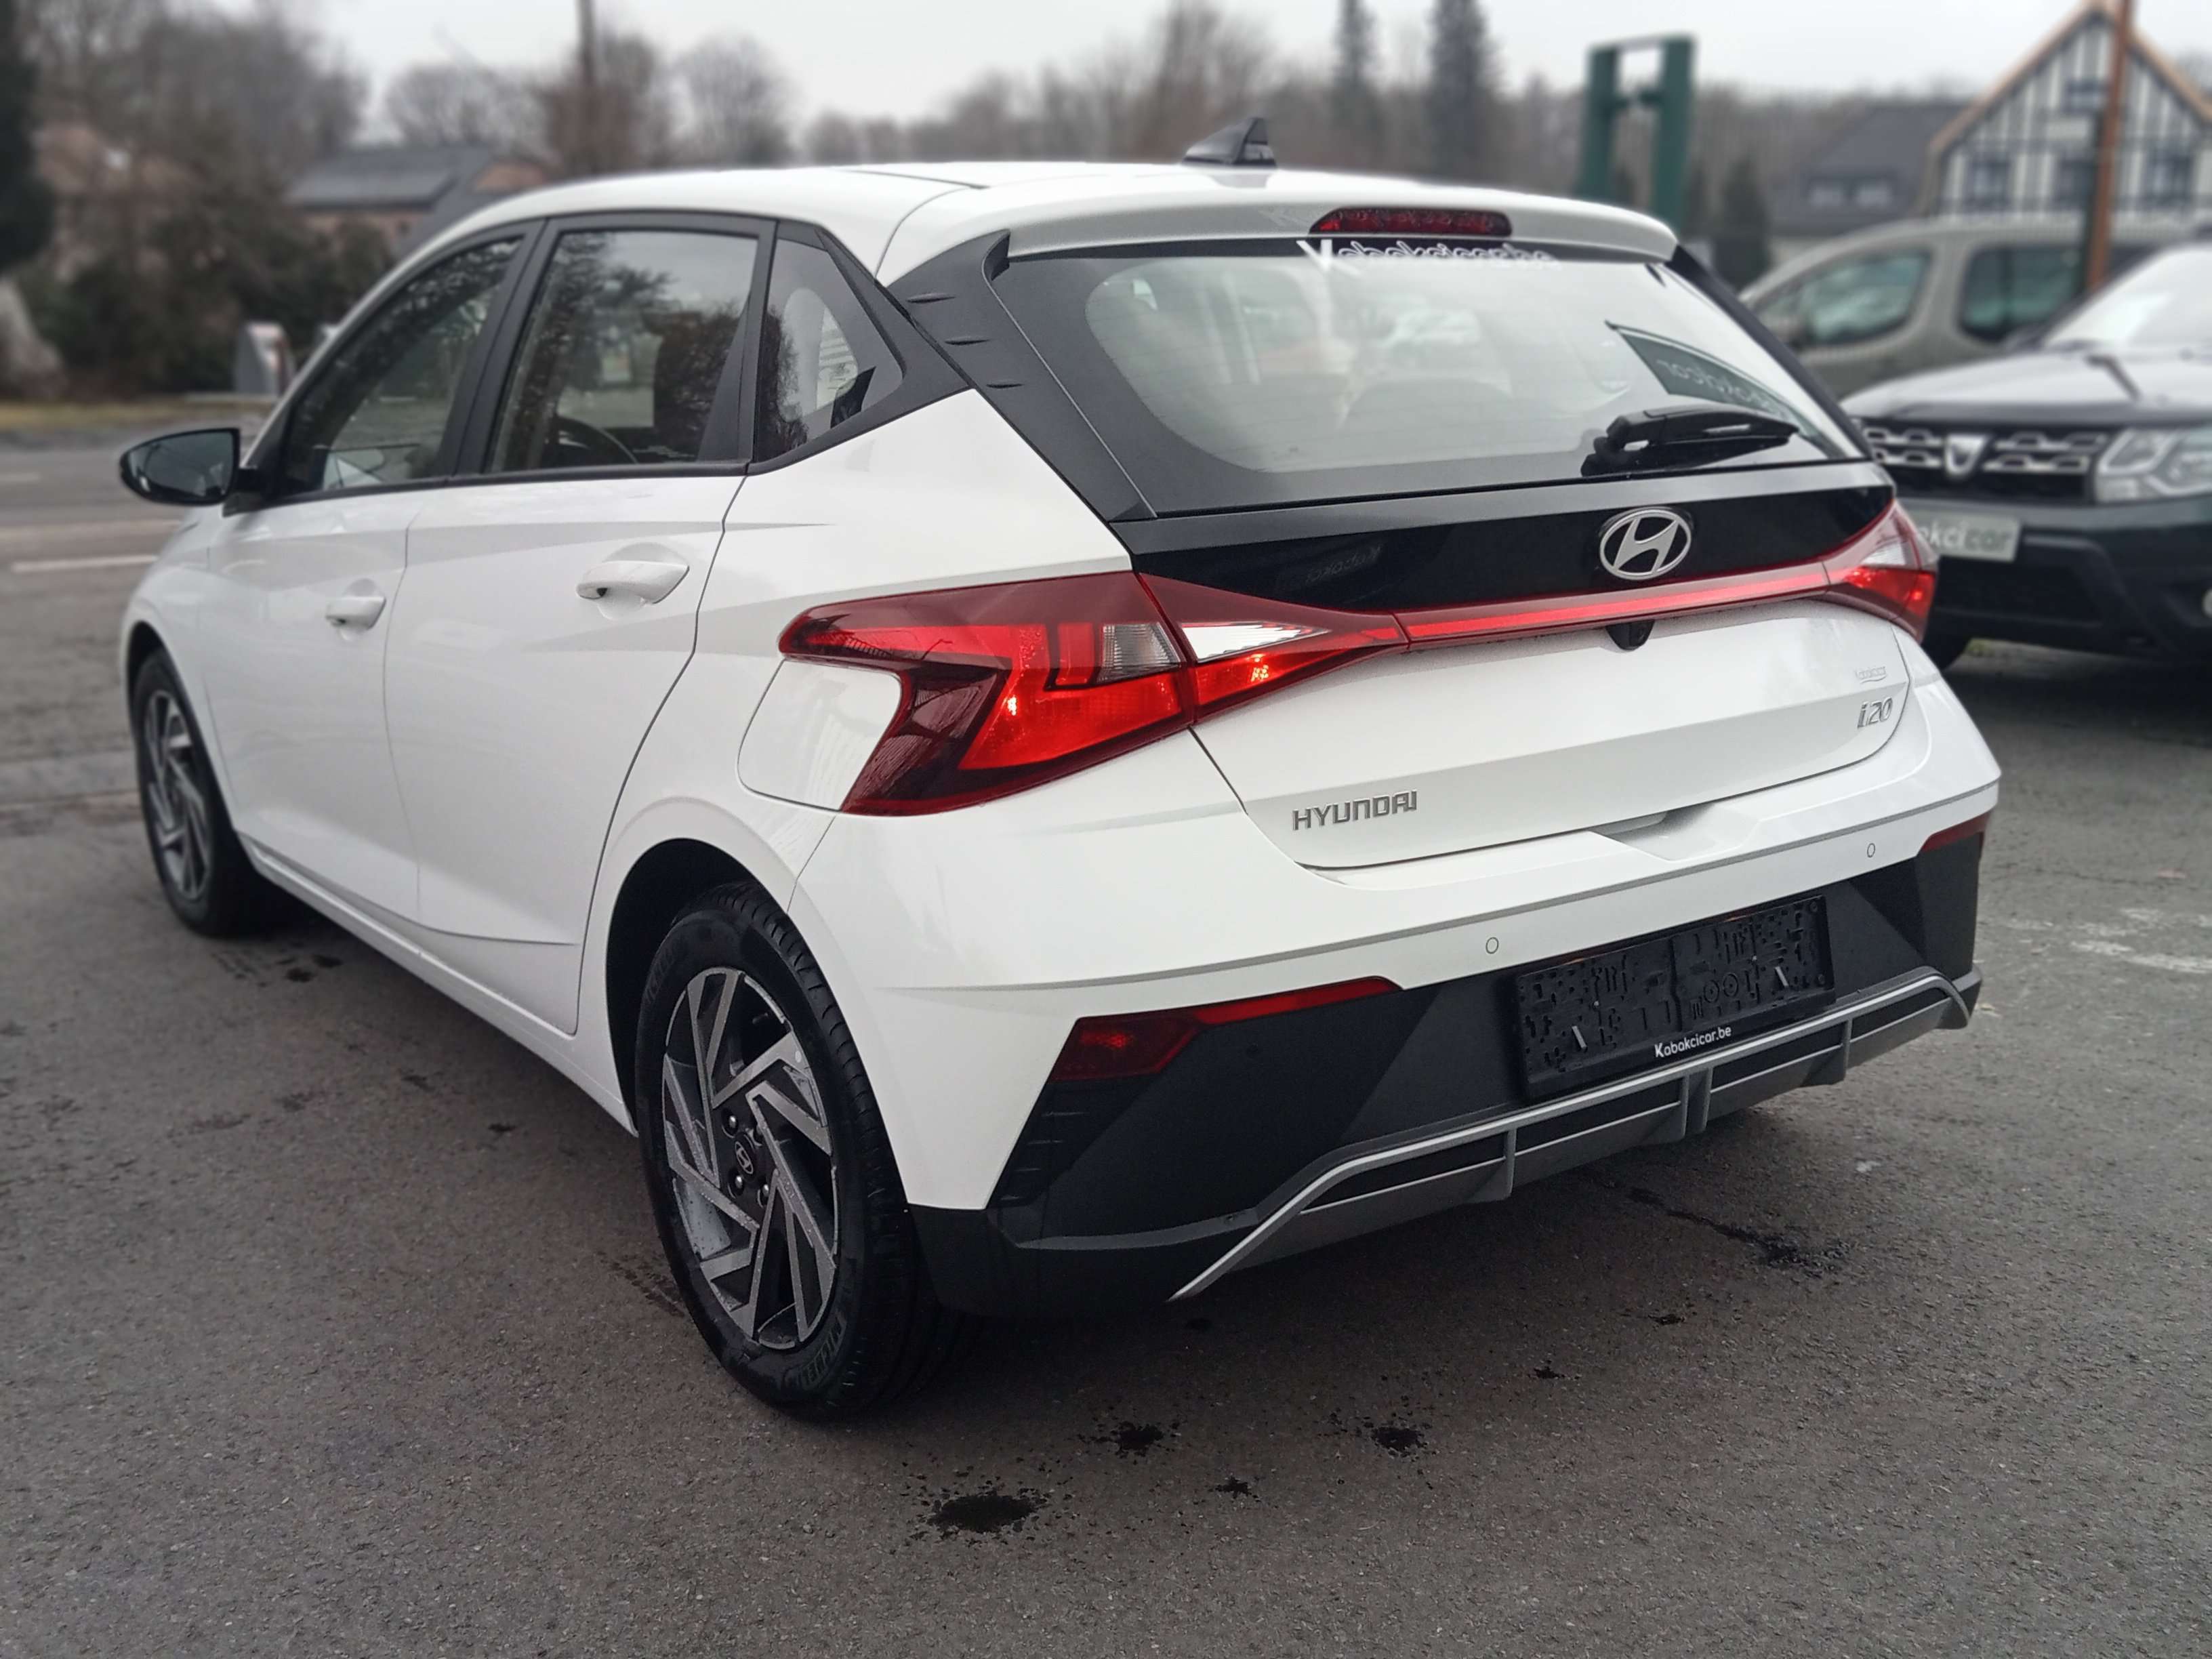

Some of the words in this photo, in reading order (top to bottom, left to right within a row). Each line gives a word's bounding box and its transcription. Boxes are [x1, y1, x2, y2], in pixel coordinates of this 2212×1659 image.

[1857, 697, 1893, 729] i20
[1292, 789, 1417, 831] HYUNDAI
[1654, 1026, 1732, 1058] Kabakcicar.be
